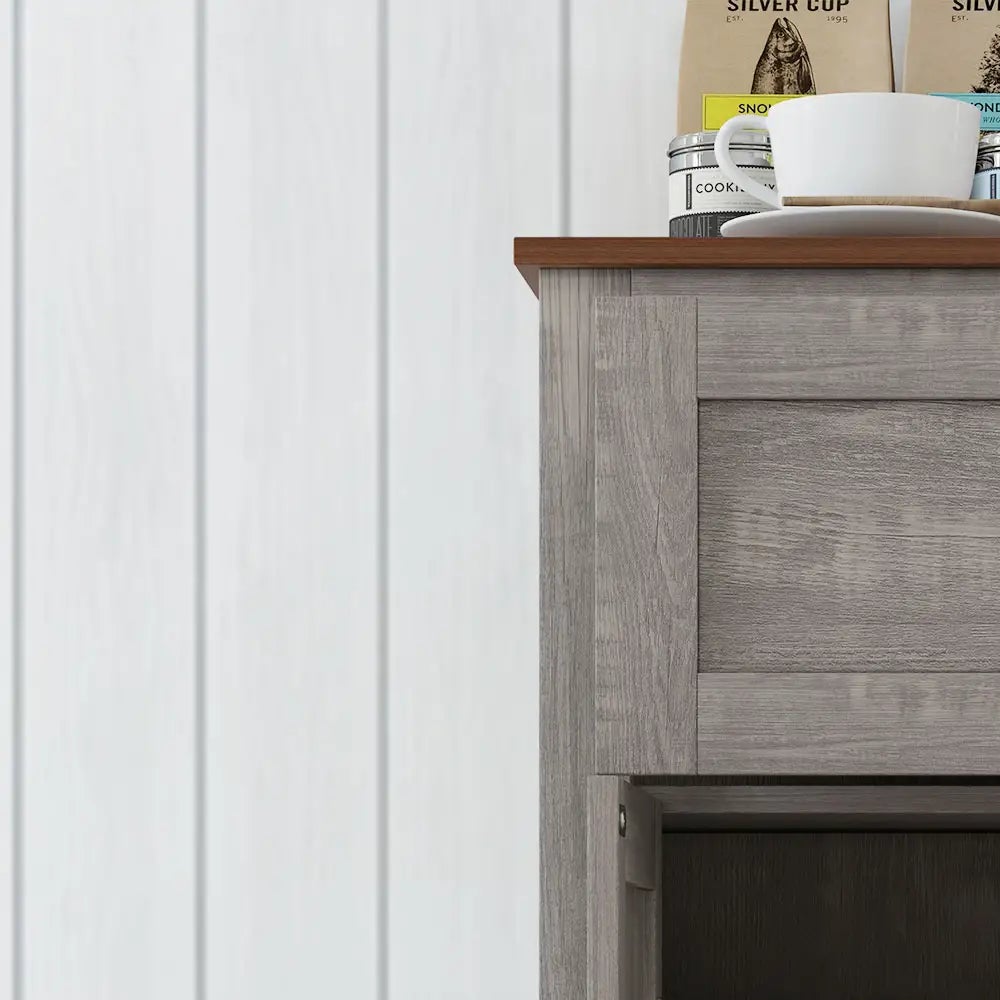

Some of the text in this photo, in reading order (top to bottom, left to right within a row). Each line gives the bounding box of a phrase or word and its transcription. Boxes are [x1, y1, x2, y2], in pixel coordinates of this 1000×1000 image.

[727, 0, 850, 12] SILVER CUP
[726, 15, 744, 23] EST.
[826, 15, 848, 24] 1995
[738, 103, 772, 114] SNO
[696, 182, 745, 194] COOKI
